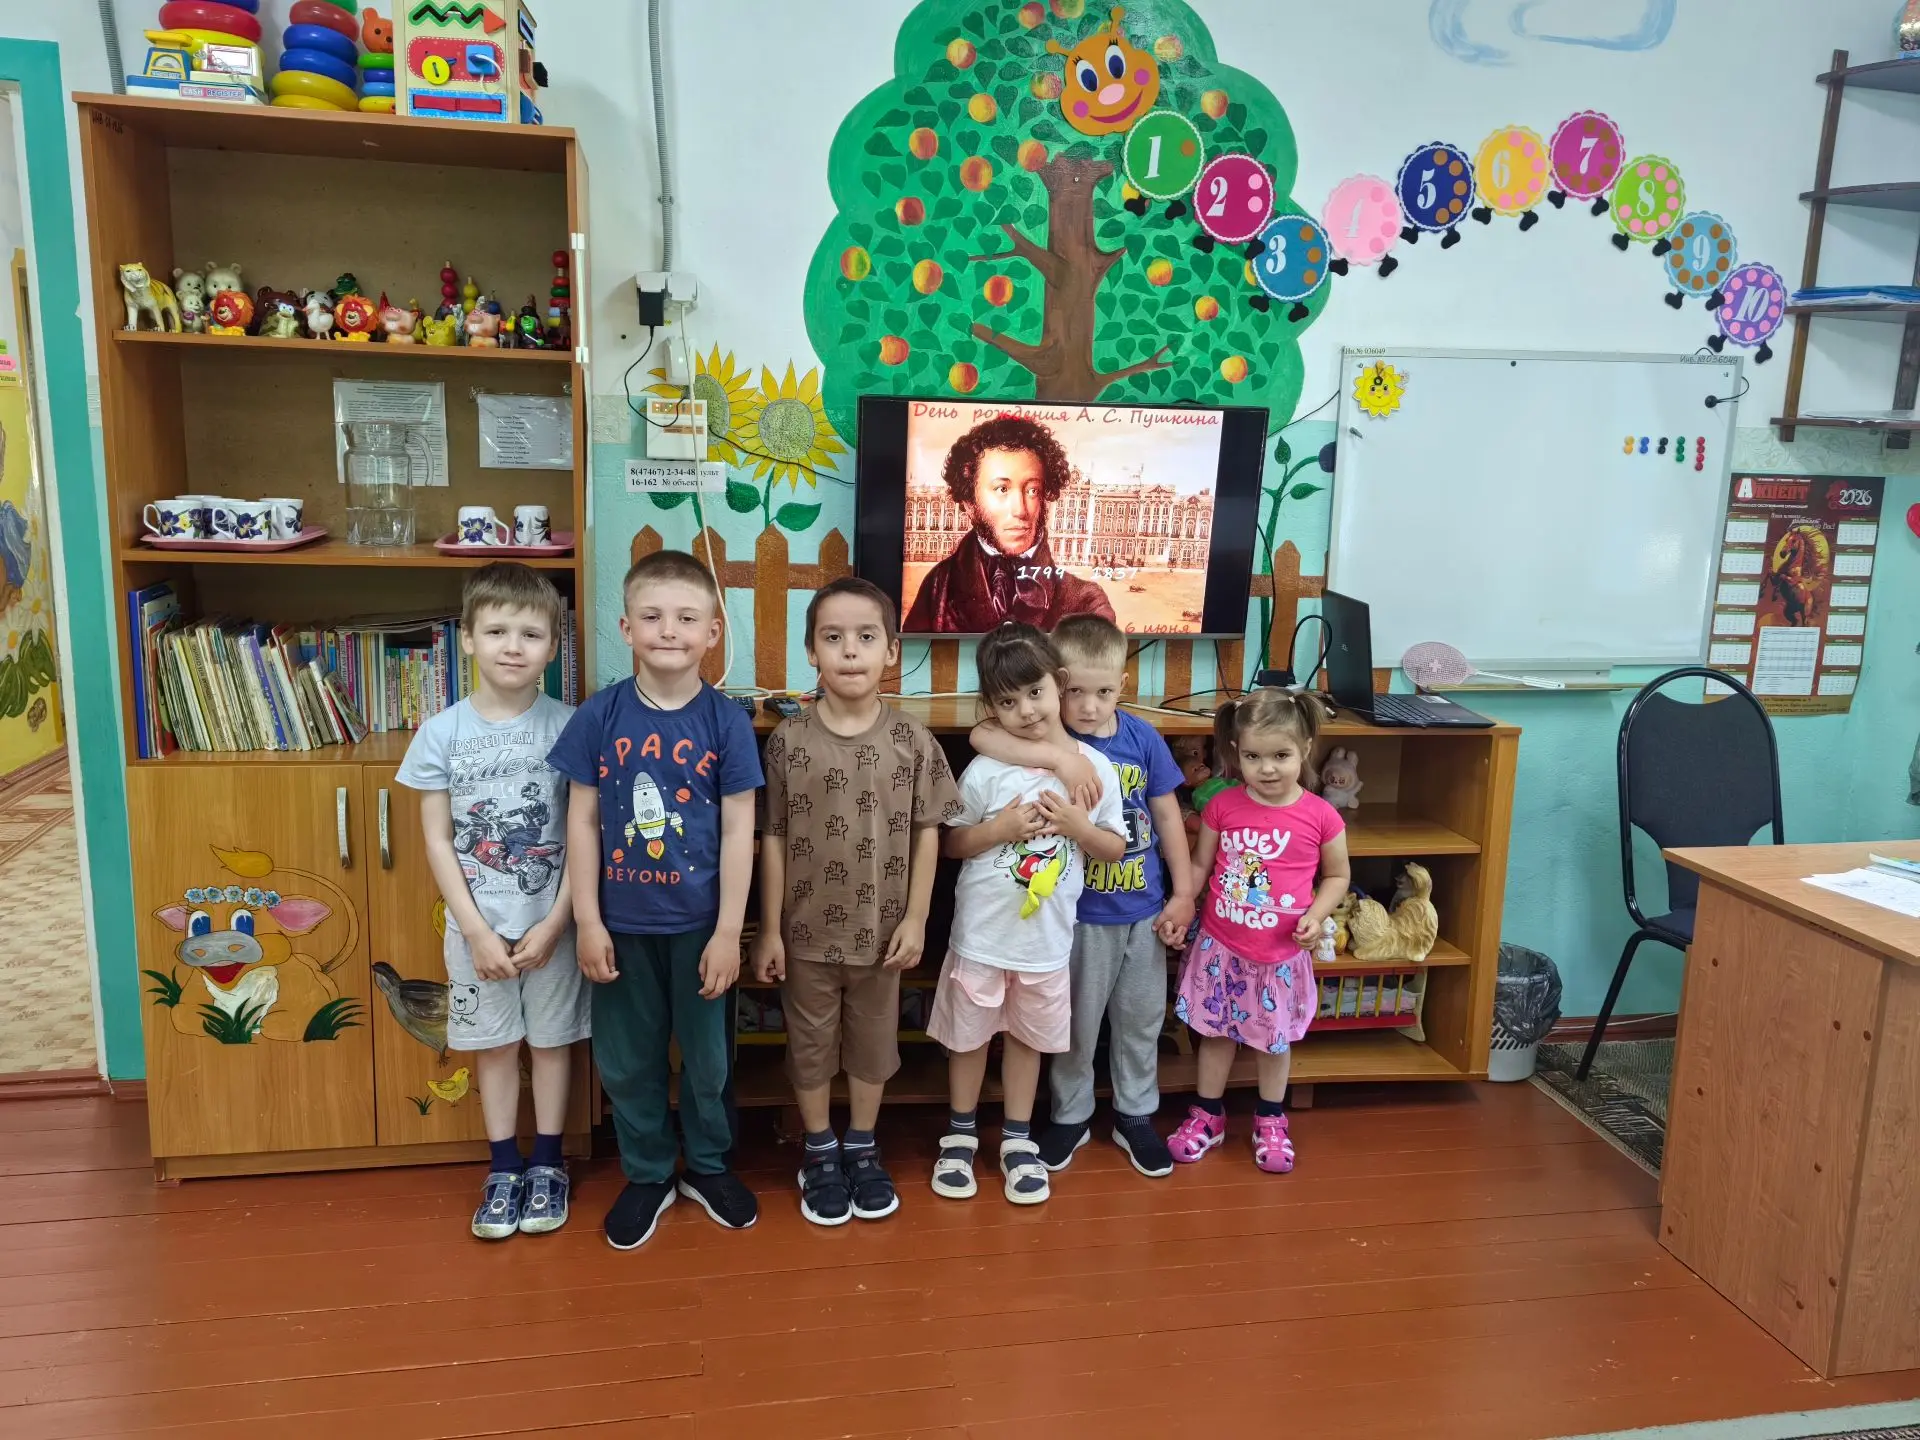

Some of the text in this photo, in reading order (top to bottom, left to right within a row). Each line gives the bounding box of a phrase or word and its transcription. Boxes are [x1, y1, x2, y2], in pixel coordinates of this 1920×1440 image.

[183, 86, 243, 98] CASH REGISTER
[1143, 135, 1162, 179] 1
[1492, 149, 1512, 190] 6
[1579, 137, 1600, 175] 7
[1205, 176, 1228, 216] 2
[1417, 168, 1437, 209] 5
[1636, 179, 1655, 217] 8
[1265, 234, 1287, 274] 3
[1693, 234, 1711, 271] 9
[1731, 284, 1770, 323] 10
[913, 403, 1219, 428] День рождения А. С. Пушкина
[630, 467, 665, 476] 8(47467)
[666, 468, 696, 476] 2-34-48
[631, 478, 657, 486] 16-162
[661, 478, 670, 486] №
[1839, 488, 1873, 506] 2026
[1016, 565, 1139, 580] 1799 1837
[1124, 622, 1192, 634] 6 июня
[464, 734, 500, 750] SPEED
[501, 731, 534, 746] TEAM
[599, 733, 718, 778] SPACE
[638, 807, 662, 822] YOU
[1220, 827, 1291, 860] BLUEY
[606, 866, 681, 884] BEYOND
[1083, 854, 1148, 894] AME
[1215, 897, 1279, 930] BINGO
